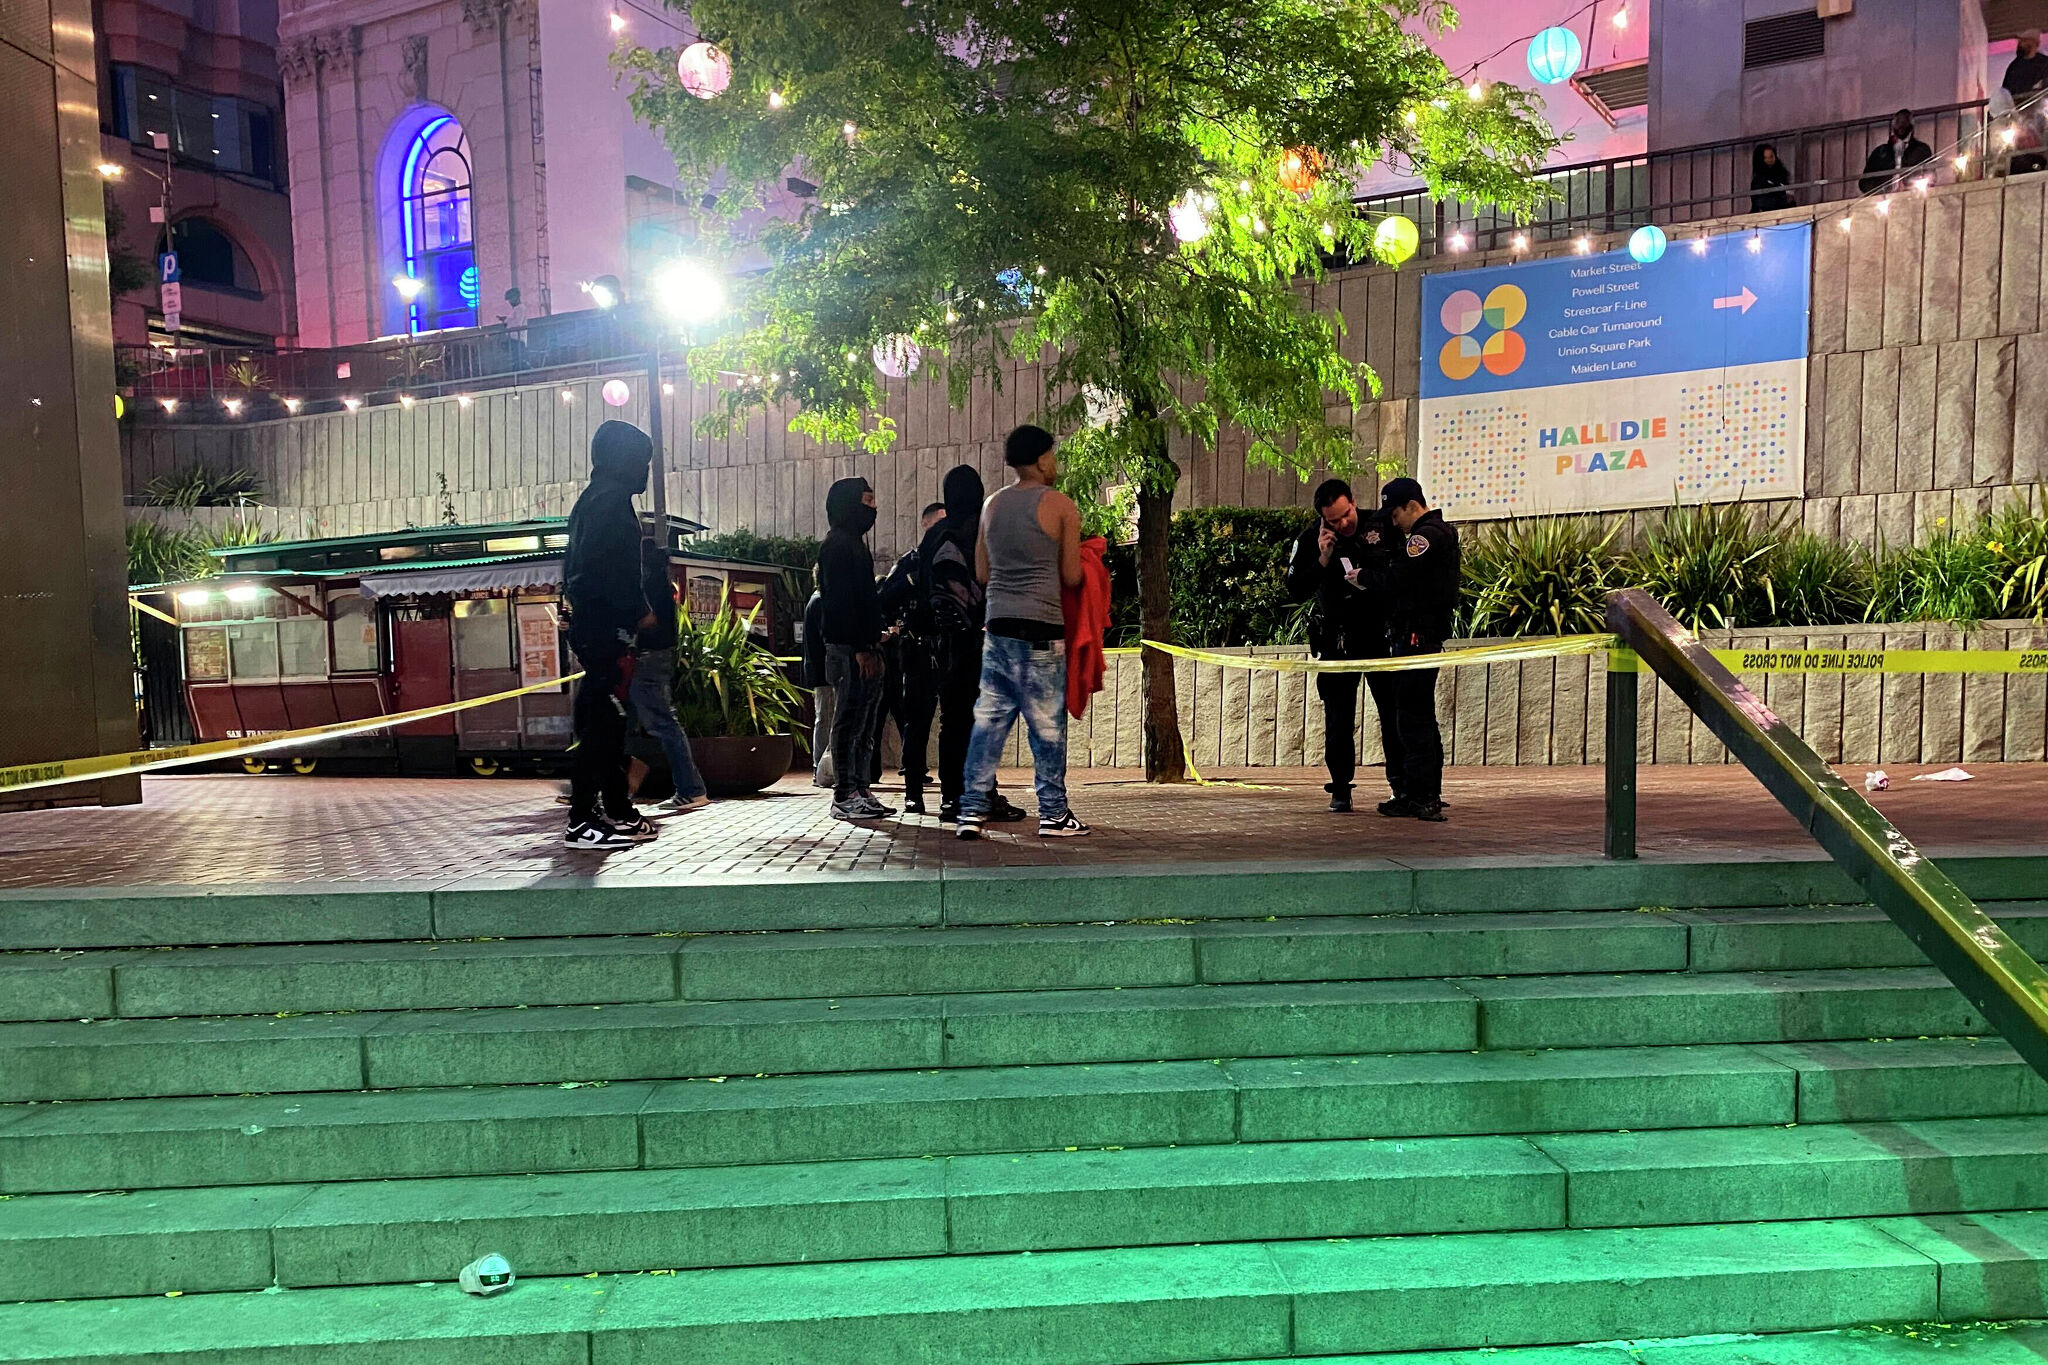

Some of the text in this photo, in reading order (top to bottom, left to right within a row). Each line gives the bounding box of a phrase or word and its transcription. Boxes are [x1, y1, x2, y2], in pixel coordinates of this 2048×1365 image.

[1570, 262, 1642, 278] Market Street
[1572, 281, 1640, 298] Powell Street
[1564, 300, 1647, 318] Streetcar F-Line
[1548, 315, 1662, 339] Cable Car Turnaround
[1558, 337, 1651, 357] Union Square Park
[1571, 360, 1637, 375] Maiden Lane
[1539, 417, 1666, 448] HALLIDIE
[1556, 448, 1648, 475] PLAZA
[226, 730, 241, 738] SAN
